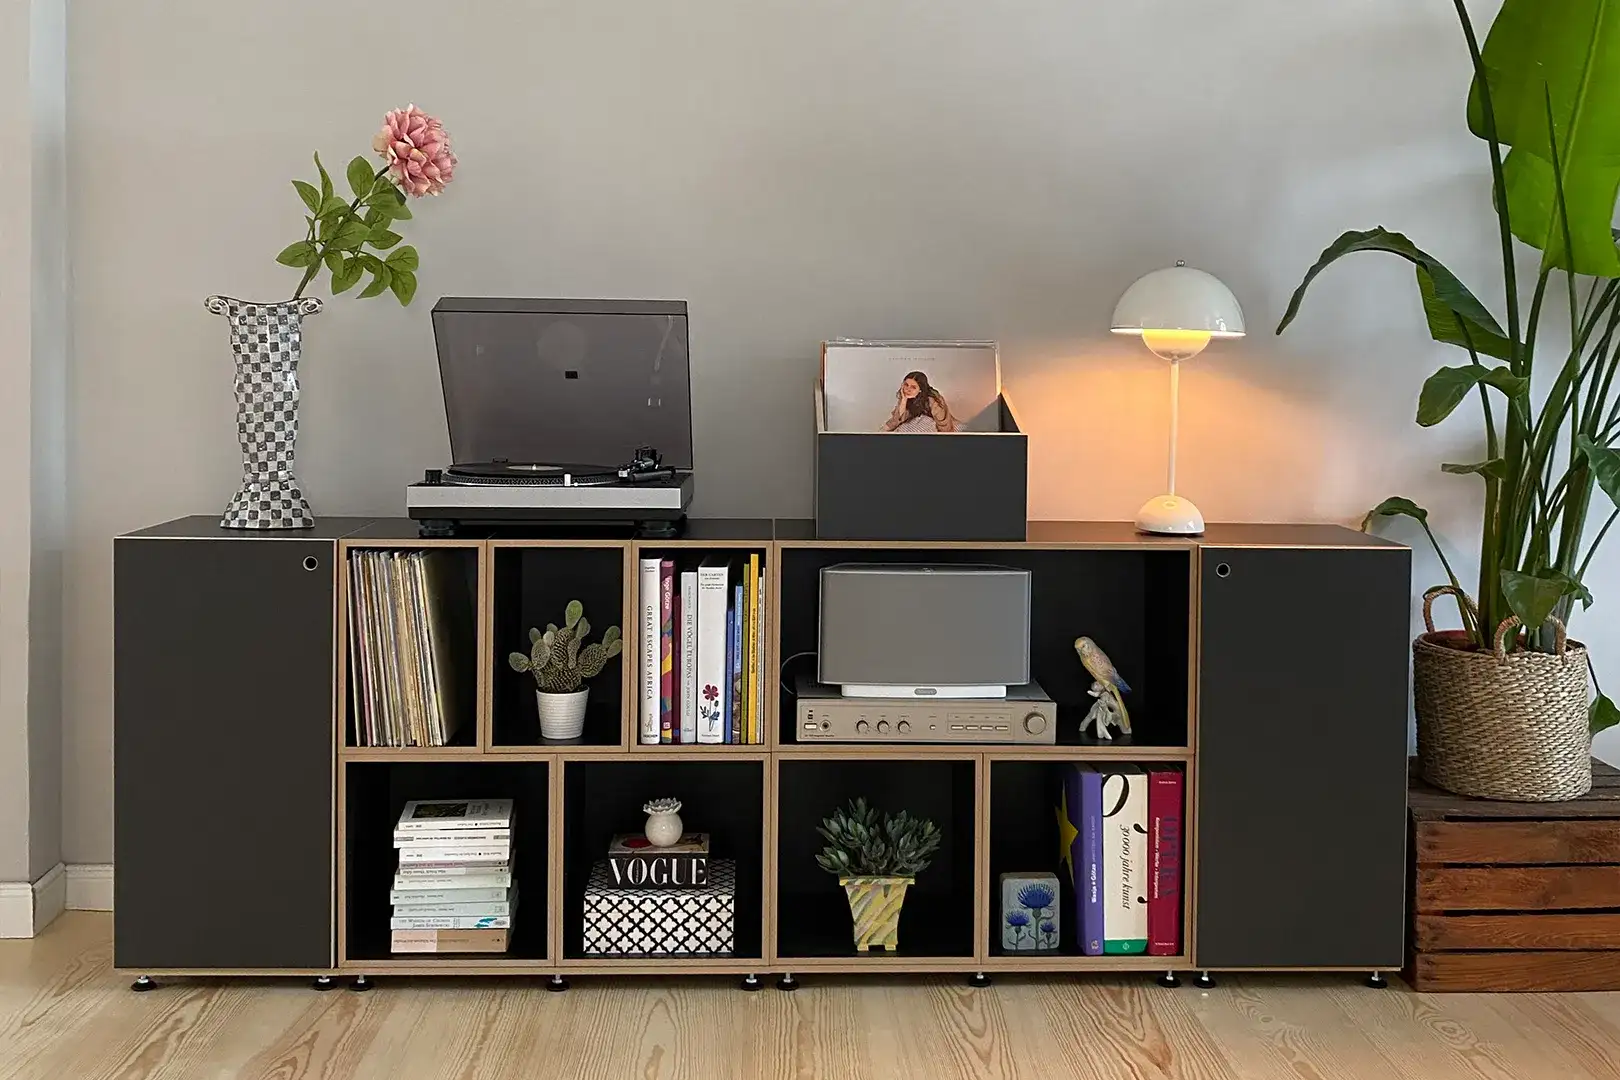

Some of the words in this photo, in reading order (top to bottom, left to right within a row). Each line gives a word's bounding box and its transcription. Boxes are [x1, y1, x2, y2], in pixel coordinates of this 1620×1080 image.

[609, 858, 707, 885] VOGUE
[1119, 856, 1133, 882] jahre
[1121, 883, 1133, 910] kunst
